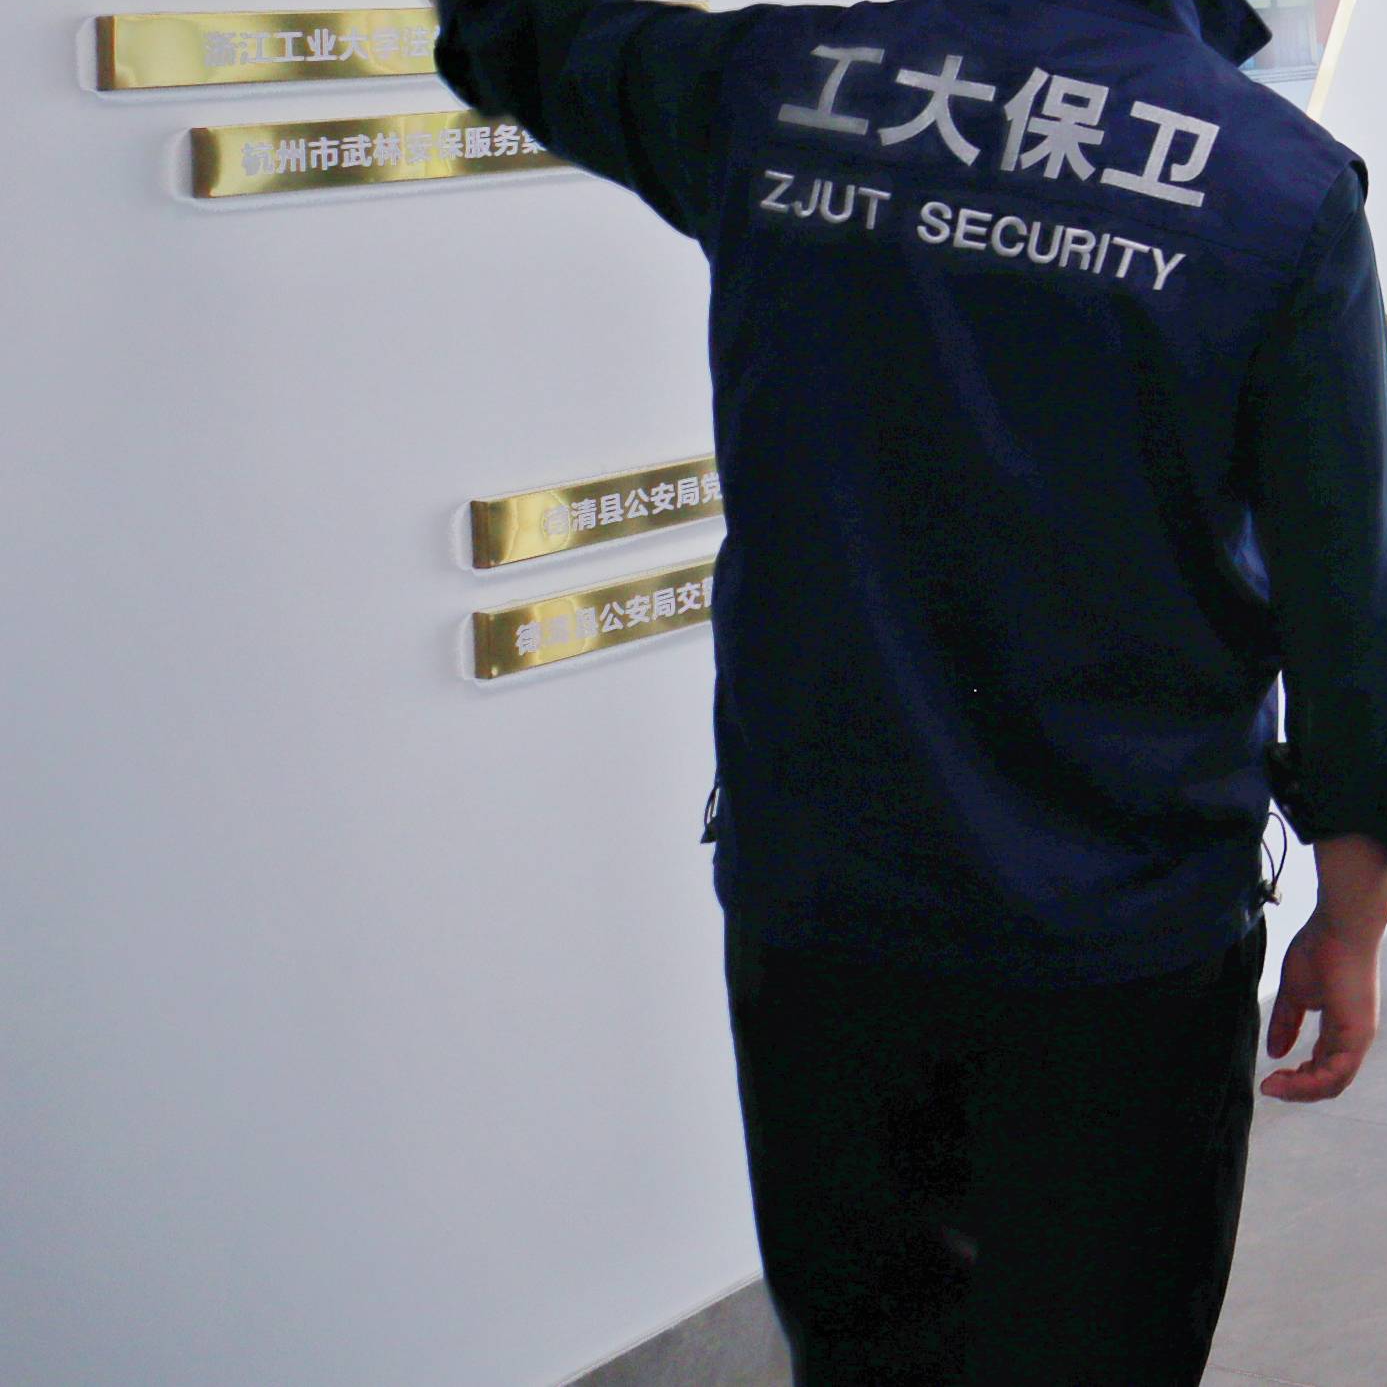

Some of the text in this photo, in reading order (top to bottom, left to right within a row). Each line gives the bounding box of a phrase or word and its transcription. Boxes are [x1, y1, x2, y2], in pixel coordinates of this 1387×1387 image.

[203, 24, 440, 68] 浙江工业大学法
[777, 44, 1221, 208] 工大保卫
[760, 170, 1186, 291] ZJUT SECURITY
